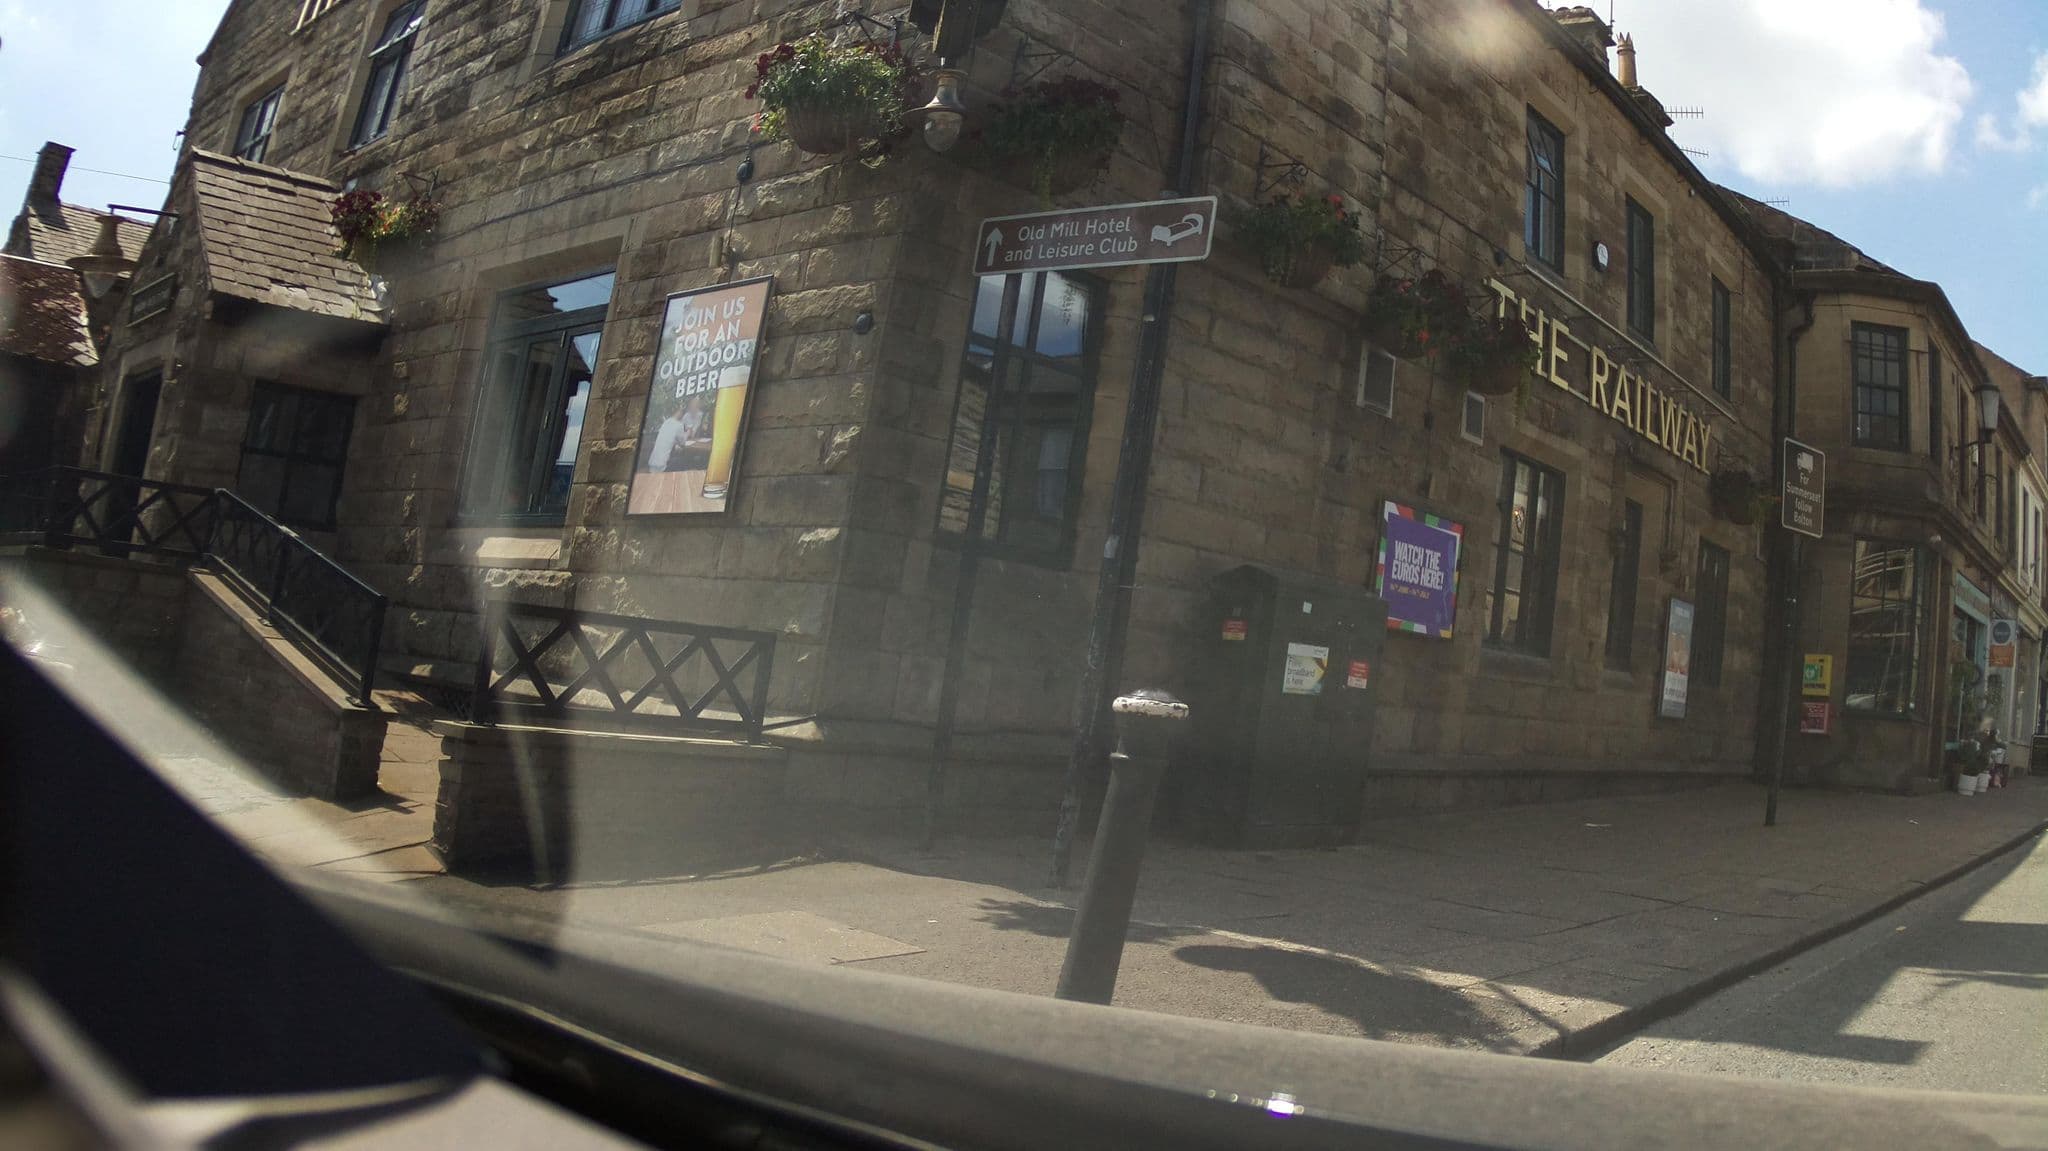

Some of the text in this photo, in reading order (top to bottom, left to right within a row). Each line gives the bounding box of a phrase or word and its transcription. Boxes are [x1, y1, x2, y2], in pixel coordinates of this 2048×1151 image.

[1018, 216, 1131, 242] Old Mill Hotel
[1004, 236, 1138, 262] and Leisure Club
[675, 296, 746, 333] JOIN US
[675, 319, 741, 354] FOR AN
[660, 341, 749, 380] OUTDOOR
[1490, 277, 1711, 475] THE RAILWAY
[1799, 472, 1810, 485] For
[1793, 511, 1813, 527] Bolton
[1794, 499, 1813, 513] follow
[1394, 540, 1442, 571] WATCH THE
[1391, 560, 1421, 585] EUROS
[1420, 568, 1445, 591] HERE!
